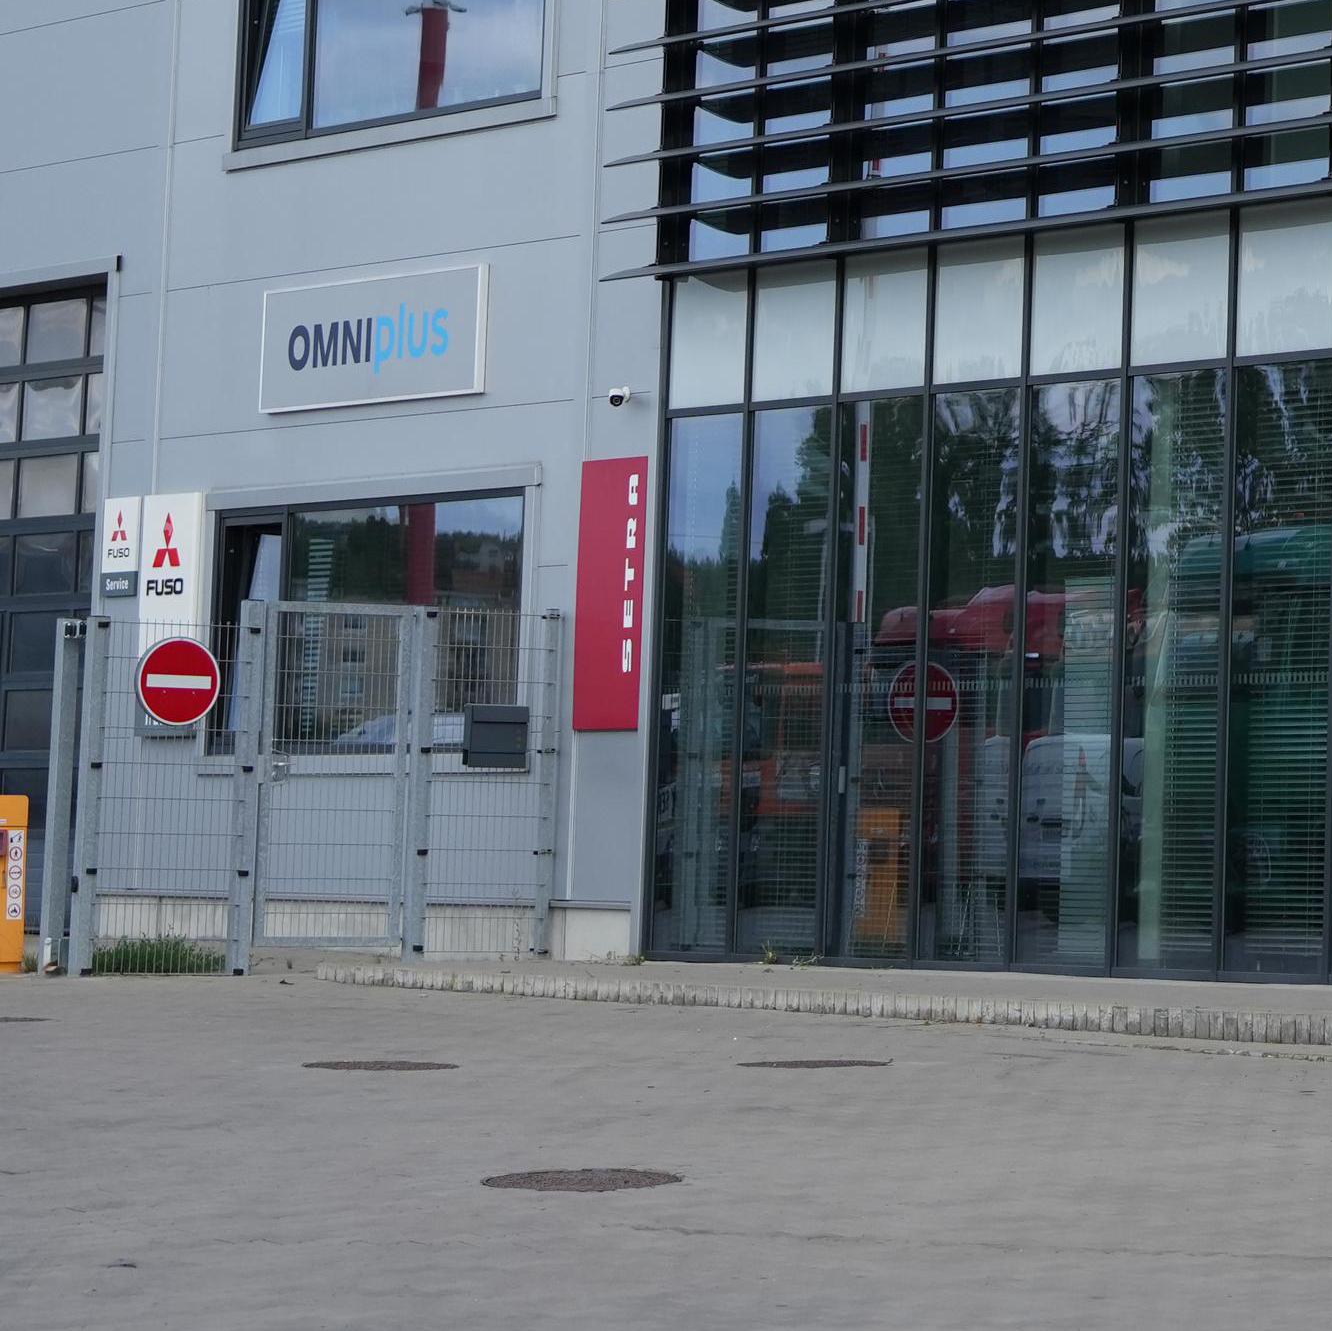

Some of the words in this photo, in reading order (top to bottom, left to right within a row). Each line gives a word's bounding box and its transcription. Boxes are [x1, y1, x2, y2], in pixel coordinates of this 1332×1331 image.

[288, 301, 449, 374] OMNIplus
[107, 547, 130, 559] FUSO
[622, 473, 640, 674] SETRA
[105, 577, 129, 591] Service
[146, 577, 184, 597] FUSO
